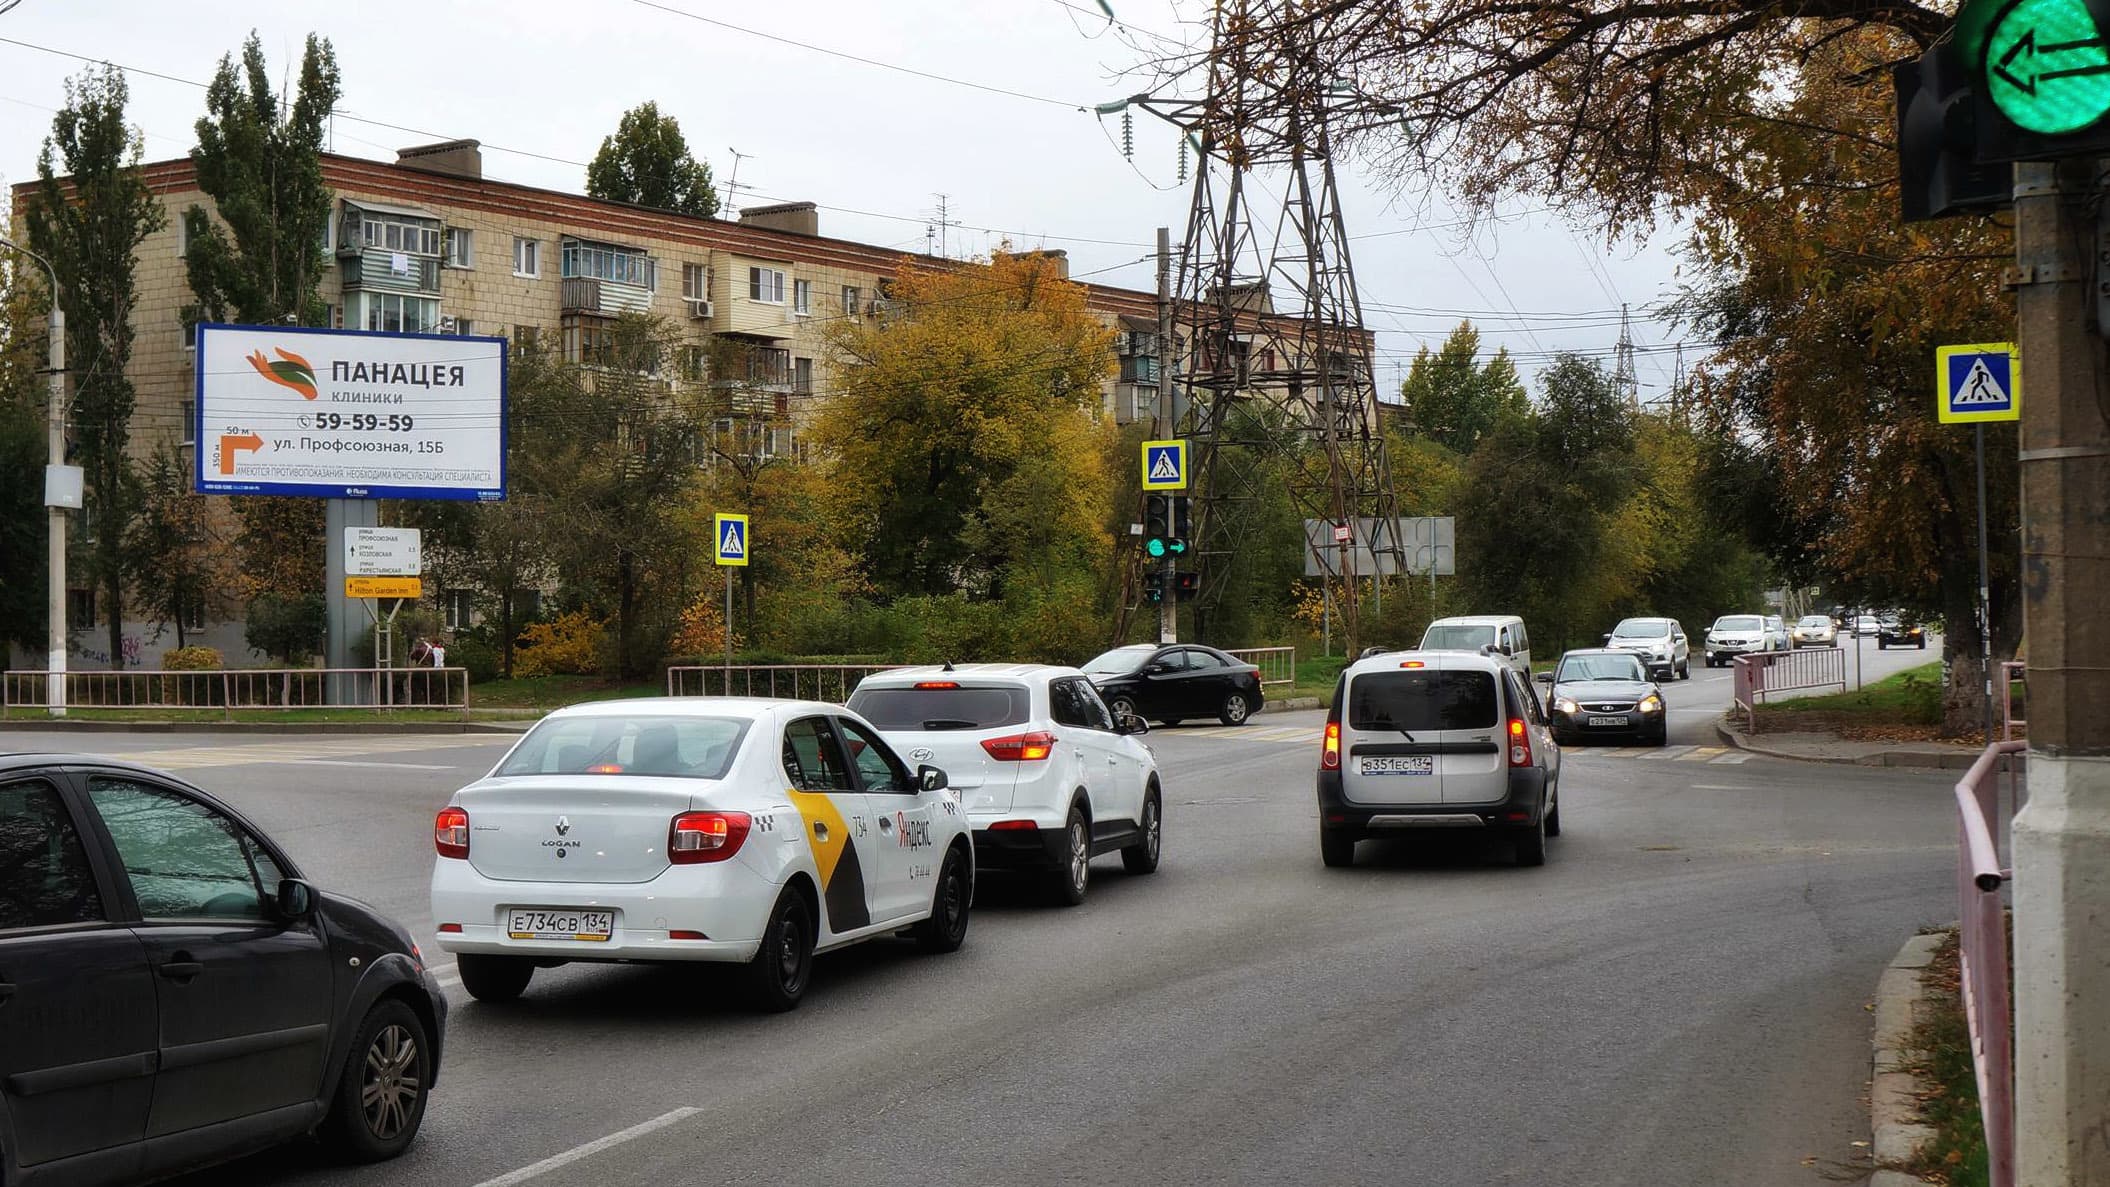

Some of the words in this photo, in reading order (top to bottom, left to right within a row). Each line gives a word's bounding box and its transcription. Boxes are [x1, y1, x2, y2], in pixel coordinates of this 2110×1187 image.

[332, 360, 464, 389] ПАНАЦЕЯ
[226, 426, 239, 435] 50
[316, 412, 414, 432] 59-59-59
[273, 439, 295, 452] ул.
[301, 437, 413, 454] Профсоюзная,
[417, 440, 444, 454] 15Б
[236, 467, 269, 477] ИМЕЮТСЯ
[346, 470, 391, 480] НЕОБХОДИМА
[392, 471, 443, 481] КОНСУЛЬТАЦИЯ
[444, 472, 491, 482] СПЕЦИАЛИСТА
[1366, 758, 1409, 770] В351ЕС
[897, 811, 932, 852] Яндекс
[541, 840, 581, 848] LOGAN
[514, 912, 578, 932] Е734СВ
[582, 913, 608, 929] 134
